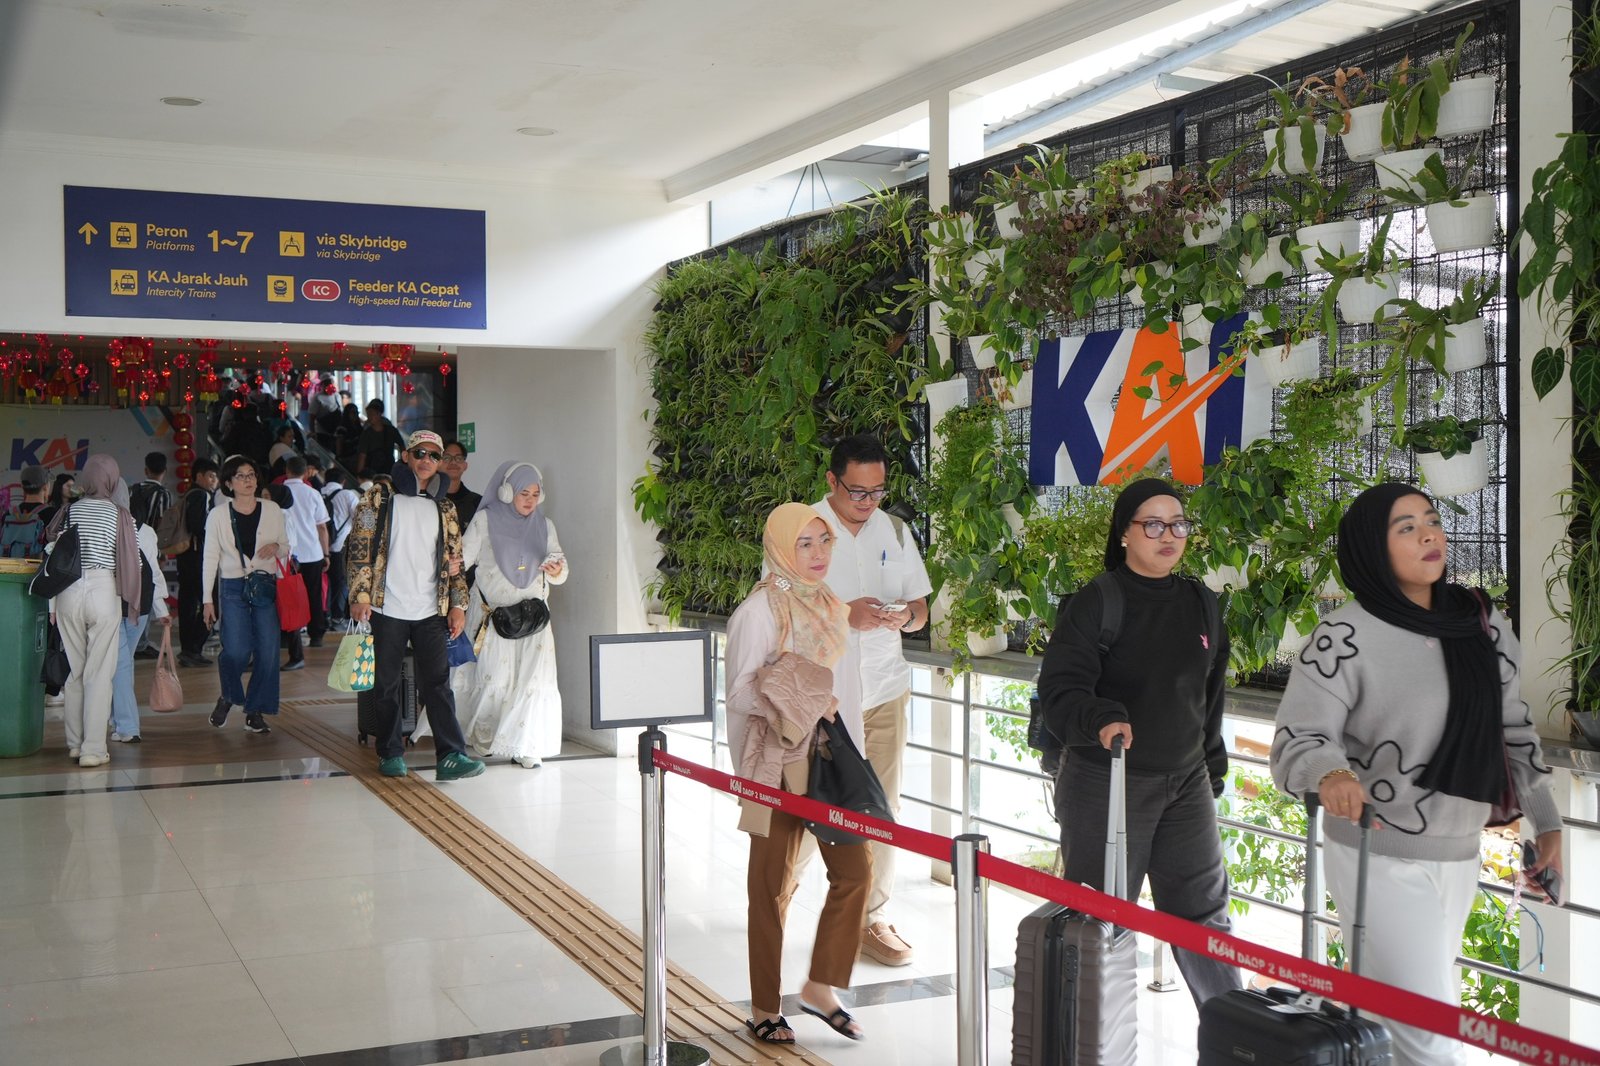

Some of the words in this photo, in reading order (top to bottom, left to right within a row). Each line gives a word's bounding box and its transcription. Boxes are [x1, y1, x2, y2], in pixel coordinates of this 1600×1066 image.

[146, 223, 188, 238] Peron
[146, 240, 195, 252] Platforms
[316, 233, 337, 246] via
[339, 233, 407, 251] Skybridge
[316, 250, 331, 259] via
[333, 249, 381, 262] Skybridge
[147, 270, 170, 283] KA
[172, 271, 212, 285] Jarak
[214, 273, 248, 287] Jauh
[146, 286, 186, 299] Intercity
[188, 288, 217, 299] Trains
[312, 285, 330, 296] KC
[349, 279, 395, 293] Feeder
[397, 281, 418, 294] KA
[420, 282, 460, 298] Cepat
[348, 295, 400, 307] High-speed
[401, 298, 419, 307] Rail
[421, 298, 451, 308] Feeder
[453, 299, 472, 309] Line
[1029, 312, 1249, 486] KAI
[10, 438, 89, 470] KAI
[730, 778, 742, 793] KAI
[829, 808, 844, 826] KAI
[844, 818, 859, 831] DAOP
[860, 823, 864, 833] 2
[865, 825, 893, 841] BANDUNG
[1207, 936, 1235, 960] KAI
[1237, 951, 1266, 970] DAOP
[1268, 962, 1276, 975] 2
[1459, 1014, 1498, 1047] KAI
[1500, 1036, 1540, 1059] DAOP
[1543, 1049, 1554, 1064] 2
